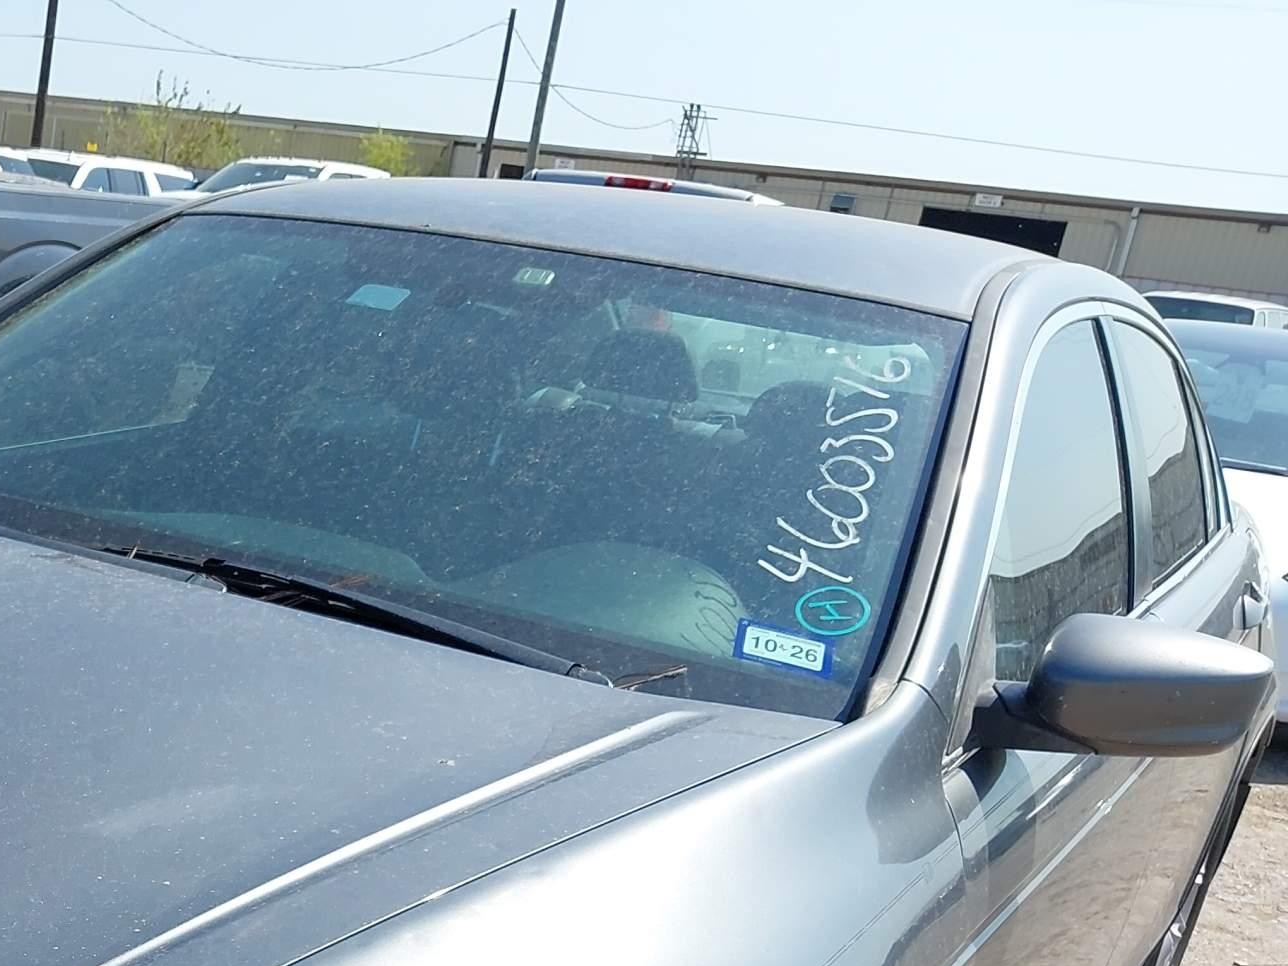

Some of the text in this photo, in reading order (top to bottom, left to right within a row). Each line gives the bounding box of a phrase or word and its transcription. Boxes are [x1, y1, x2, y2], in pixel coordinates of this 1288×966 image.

[757, 356, 912, 584] 46003516
[750, 635, 778, 653] 10
[789, 645, 818, 663] 26
